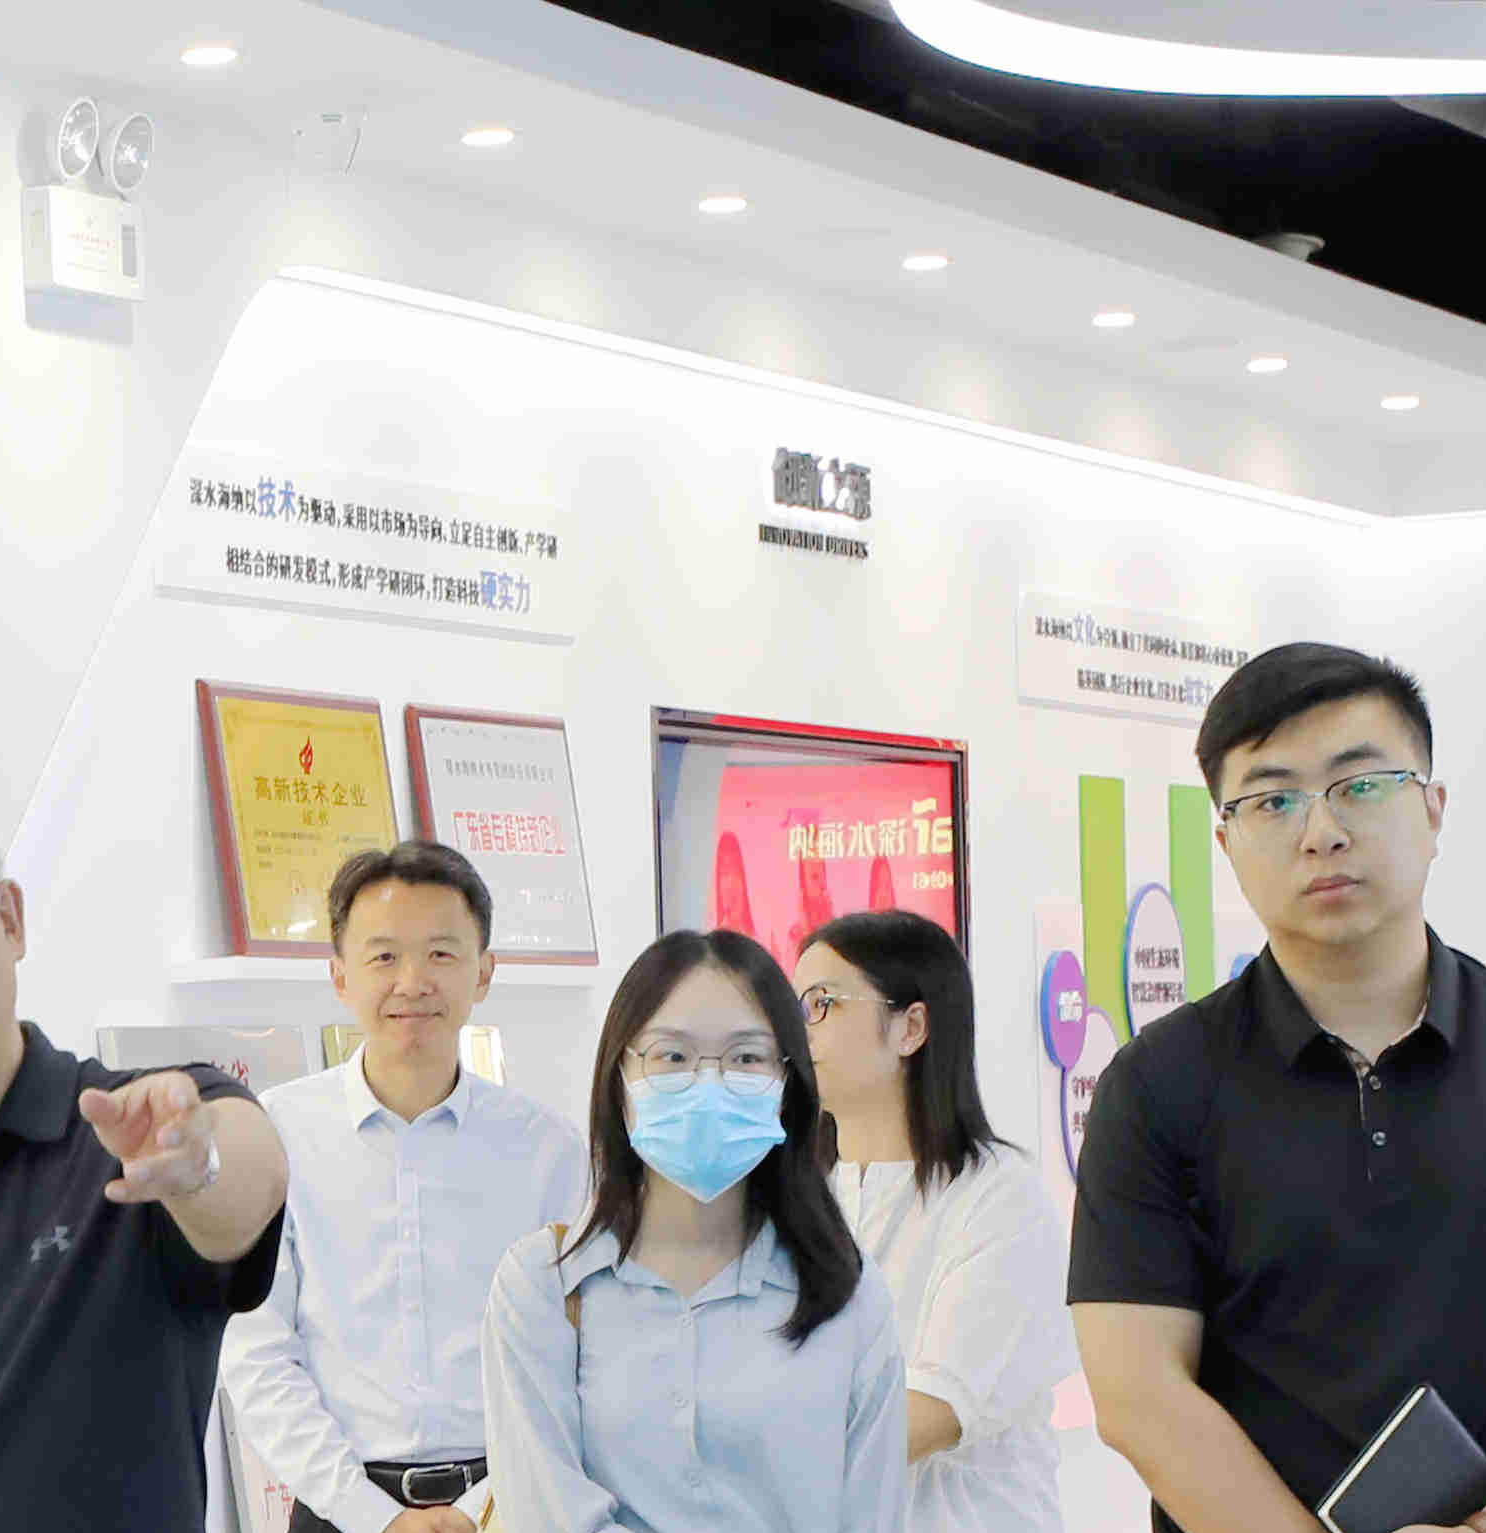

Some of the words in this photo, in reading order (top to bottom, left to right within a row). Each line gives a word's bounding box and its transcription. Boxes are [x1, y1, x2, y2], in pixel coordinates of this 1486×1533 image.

[254, 775, 369, 808] 高新技术企业
